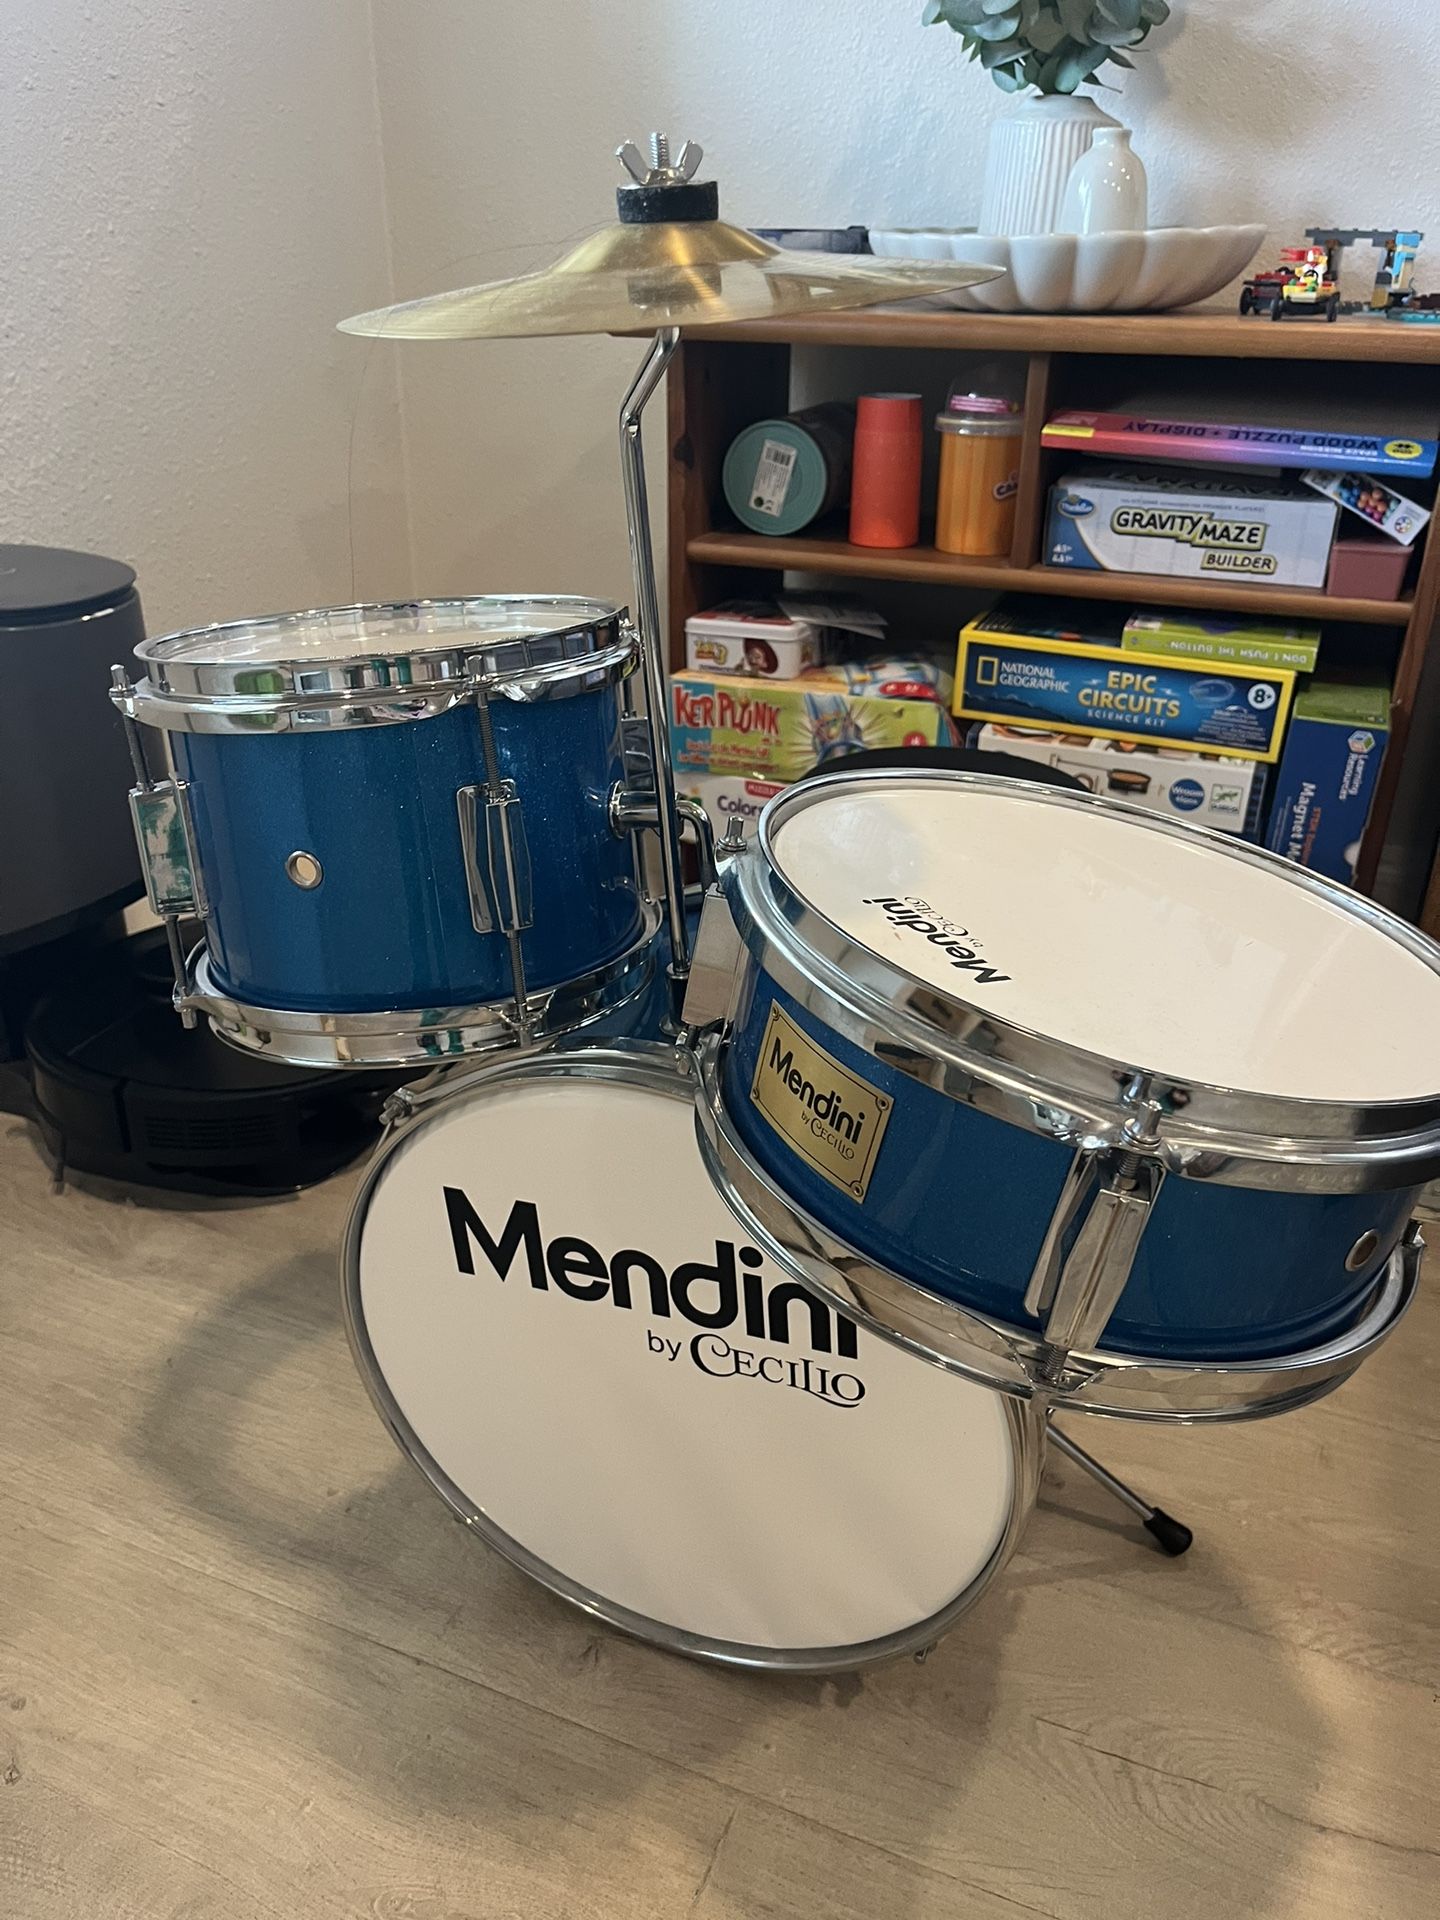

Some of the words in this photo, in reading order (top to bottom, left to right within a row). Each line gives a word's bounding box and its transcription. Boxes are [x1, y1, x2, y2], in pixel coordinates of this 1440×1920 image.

[1123, 421, 1206, 437] DISPLAY
[1228, 428, 1306, 446] PUZZLE
[1313, 434, 1379, 450] WOOD
[1114, 510, 1204, 536] GRAVITY
[1199, 524, 1262, 545] MAZE
[1206, 553, 1273, 570] BUILDER
[1001, 661, 1056, 680] NATIONAL
[999, 673, 1070, 694] GEOGRAPHIC
[1107, 670, 1157, 694] EPIC
[1077, 688, 1181, 718] CIRCUITS
[1087, 708, 1139, 725] SCIENCE
[1144, 716, 1166, 728] KIT
[717, 795, 763, 816] Color
[1291, 781, 1317, 840] Magnet
[862, 897, 1012, 984] Mendini
[769, 1036, 865, 1144] Mendini
[801, 1111, 810, 1125] by
[810, 1118, 855, 1161] CECILIO
[647, 1330, 682, 1362] by
[690, 1333, 867, 1409] CECILIO
